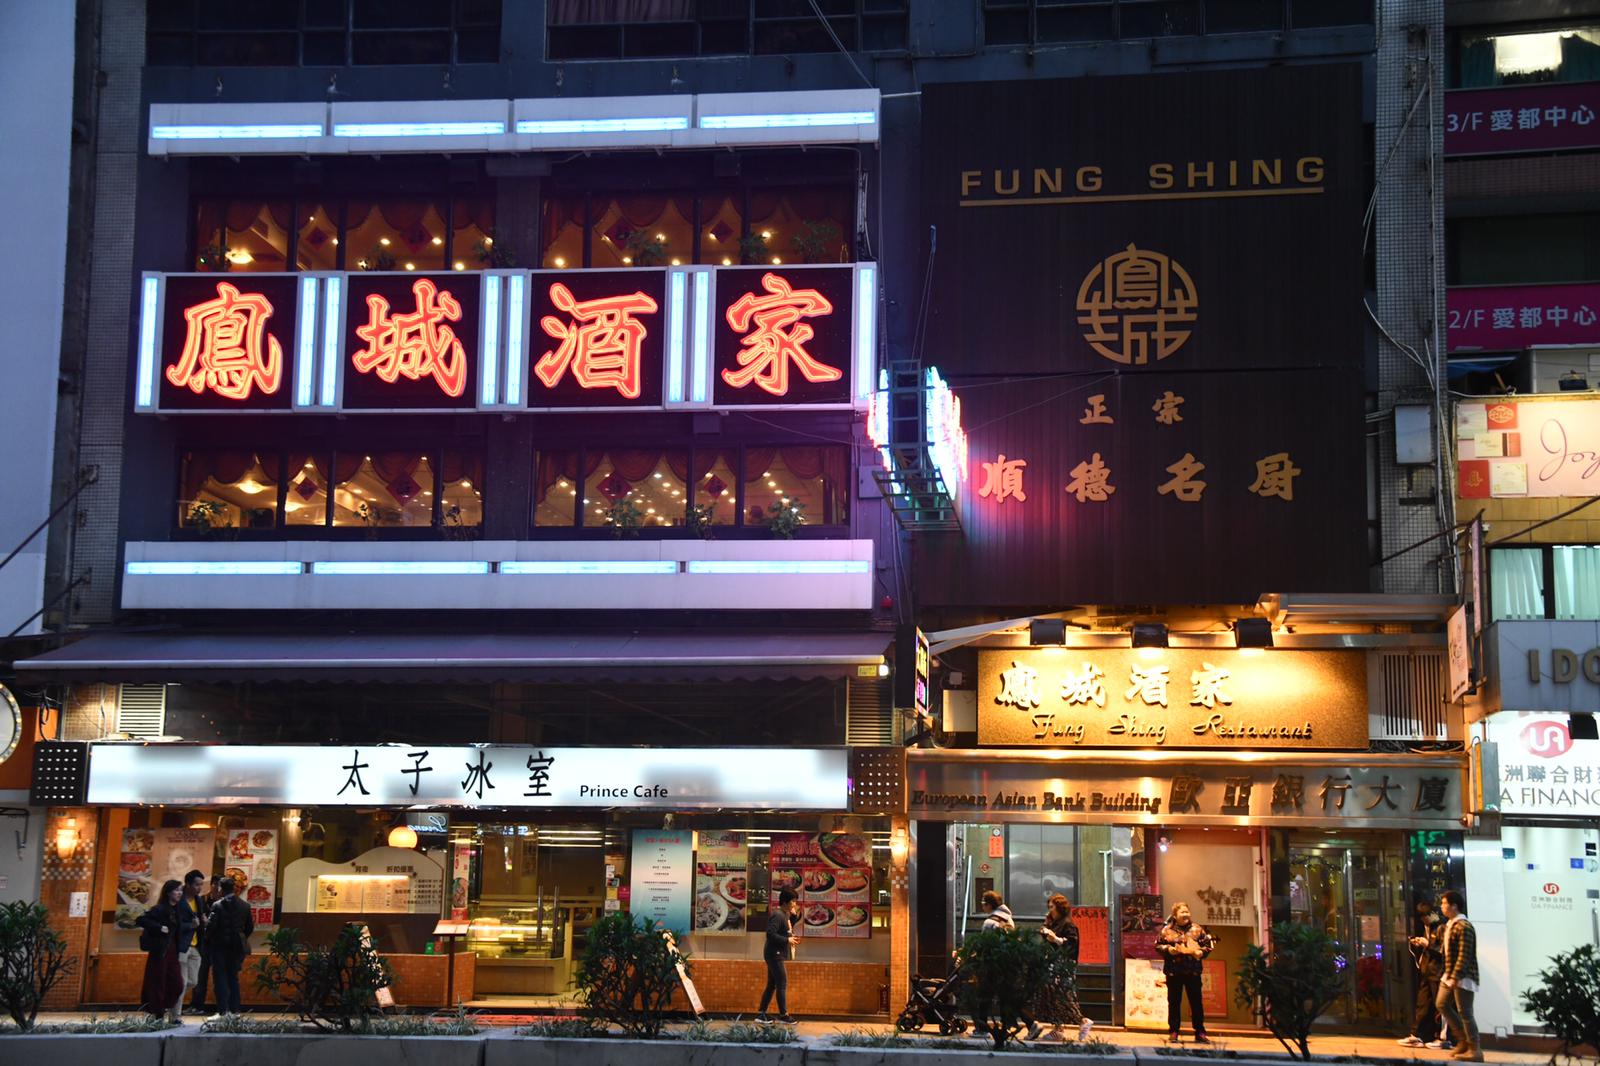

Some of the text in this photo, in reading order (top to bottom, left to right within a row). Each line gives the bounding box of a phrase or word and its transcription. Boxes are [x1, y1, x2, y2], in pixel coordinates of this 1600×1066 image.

[1447, 104, 1595, 133] 3/F 愛都中心
[960, 156, 1326, 196] FUNG SHING
[1448, 305, 1597, 330] 2/F 愛都中心
[166, 272, 844, 401] 鳳城酒家
[1079, 391, 1185, 425] 正宗
[994, 661, 1233, 710] 鳳城酒家
[1032, 713, 1313, 743] Fung Shing Restaurant
[336, 749, 555, 799] 太子冰室
[1499, 763, 1600, 783] 洲聯合財
[580, 784, 669, 798] Prince Cafe
[911, 790, 1162, 814] European Asian Bank Building
[1167, 774, 1449, 815] 歐亞銀行大廈
